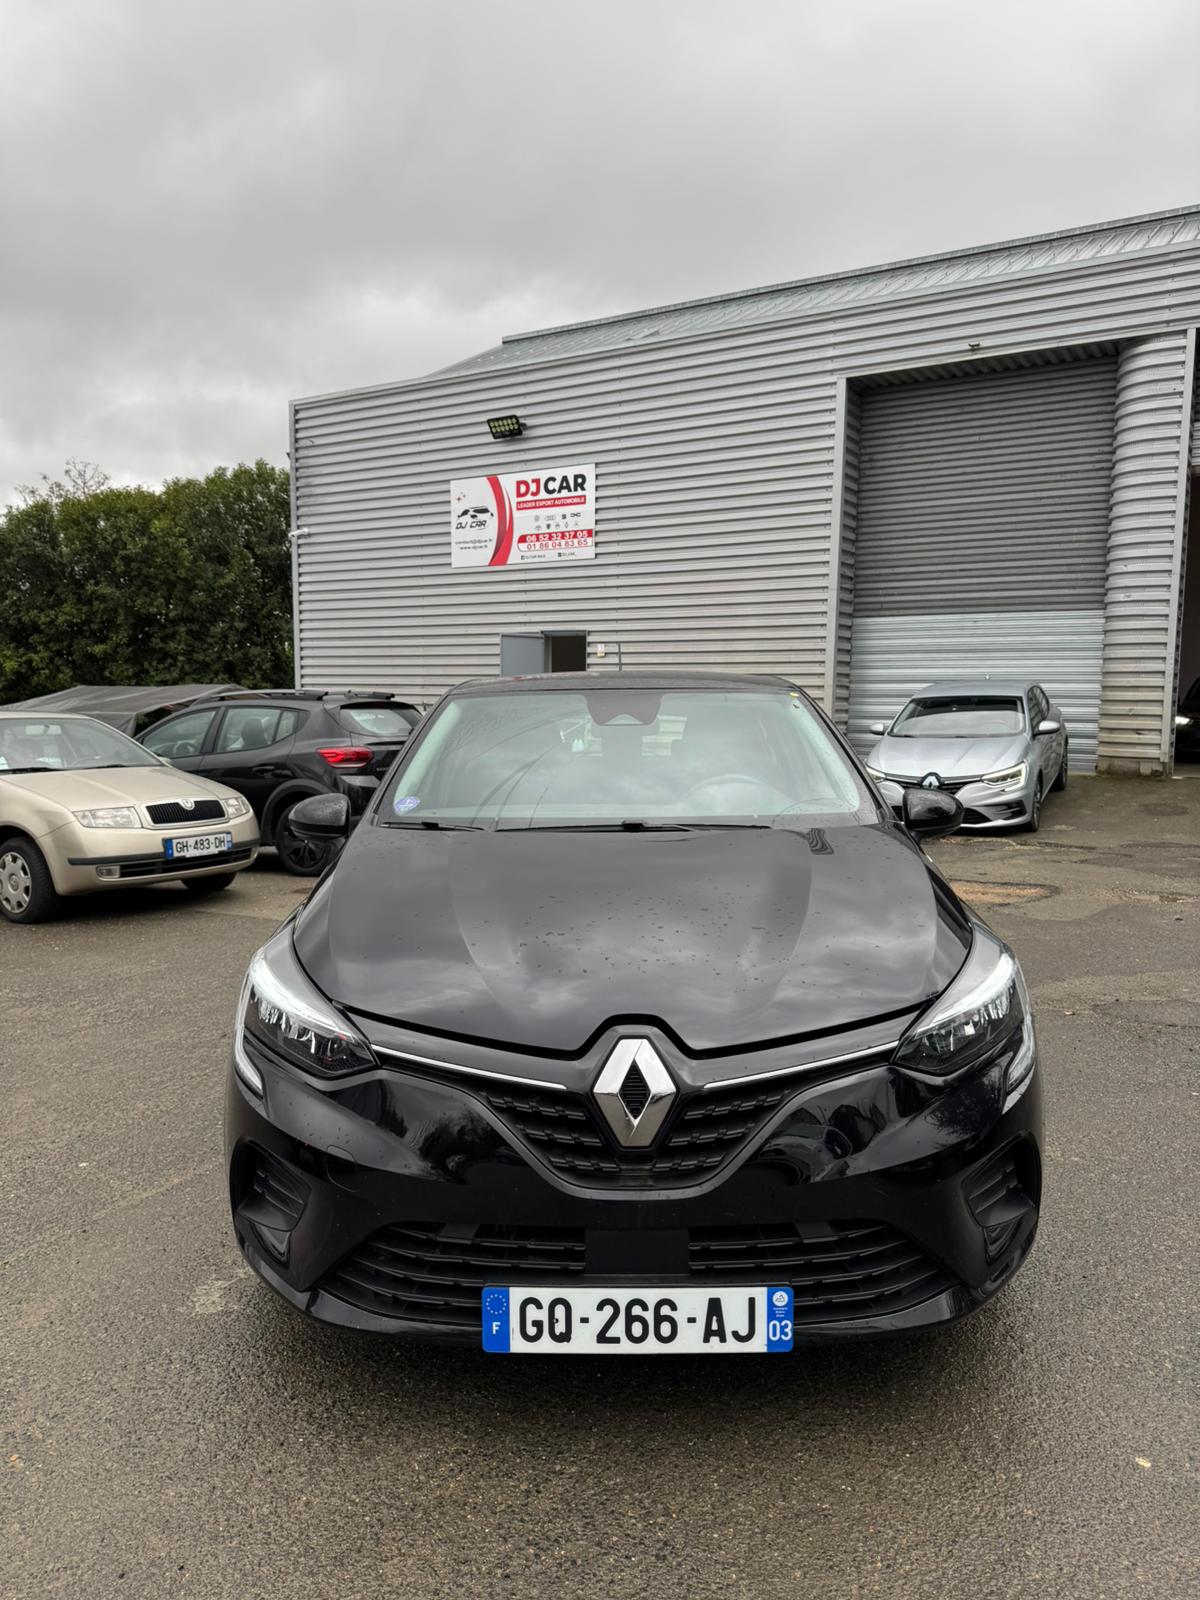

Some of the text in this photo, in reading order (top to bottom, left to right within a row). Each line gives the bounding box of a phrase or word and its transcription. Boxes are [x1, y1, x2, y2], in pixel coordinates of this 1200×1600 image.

[516, 473, 587, 498] DJ CAR
[554, 497, 585, 505] AUTOMOBILE
[526, 530, 588, 543] 06 52 32 37 05
[551, 541, 562, 549] 04
[176, 836, 226, 853] GH-483-DH
[519, 1296, 757, 1344] GQ-266-AJ
[492, 1322, 500, 1334] F
[768, 1319, 792, 1341] 03
